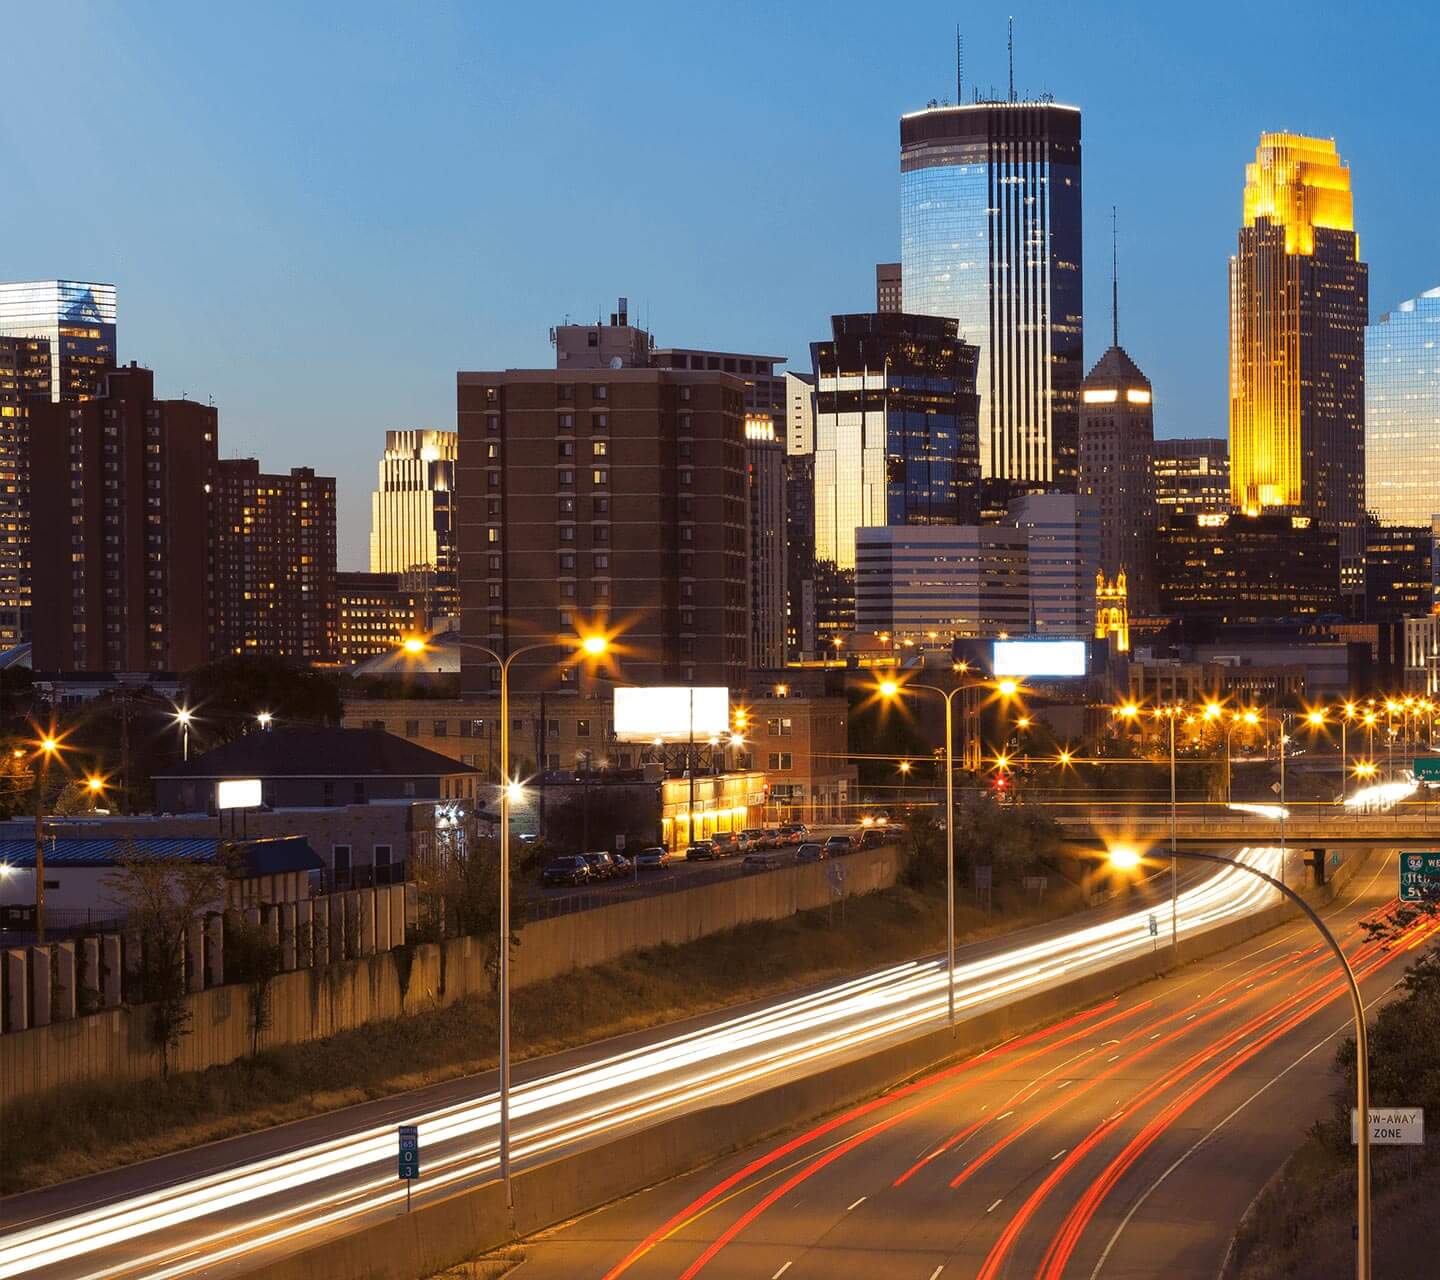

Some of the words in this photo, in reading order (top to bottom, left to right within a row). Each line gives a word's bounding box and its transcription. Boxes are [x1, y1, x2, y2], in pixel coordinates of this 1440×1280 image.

[1369, 1114, 1416, 1124] W-AWAY
[1374, 1128, 1402, 1138] ZONE
[405, 1151, 412, 1161] 0
